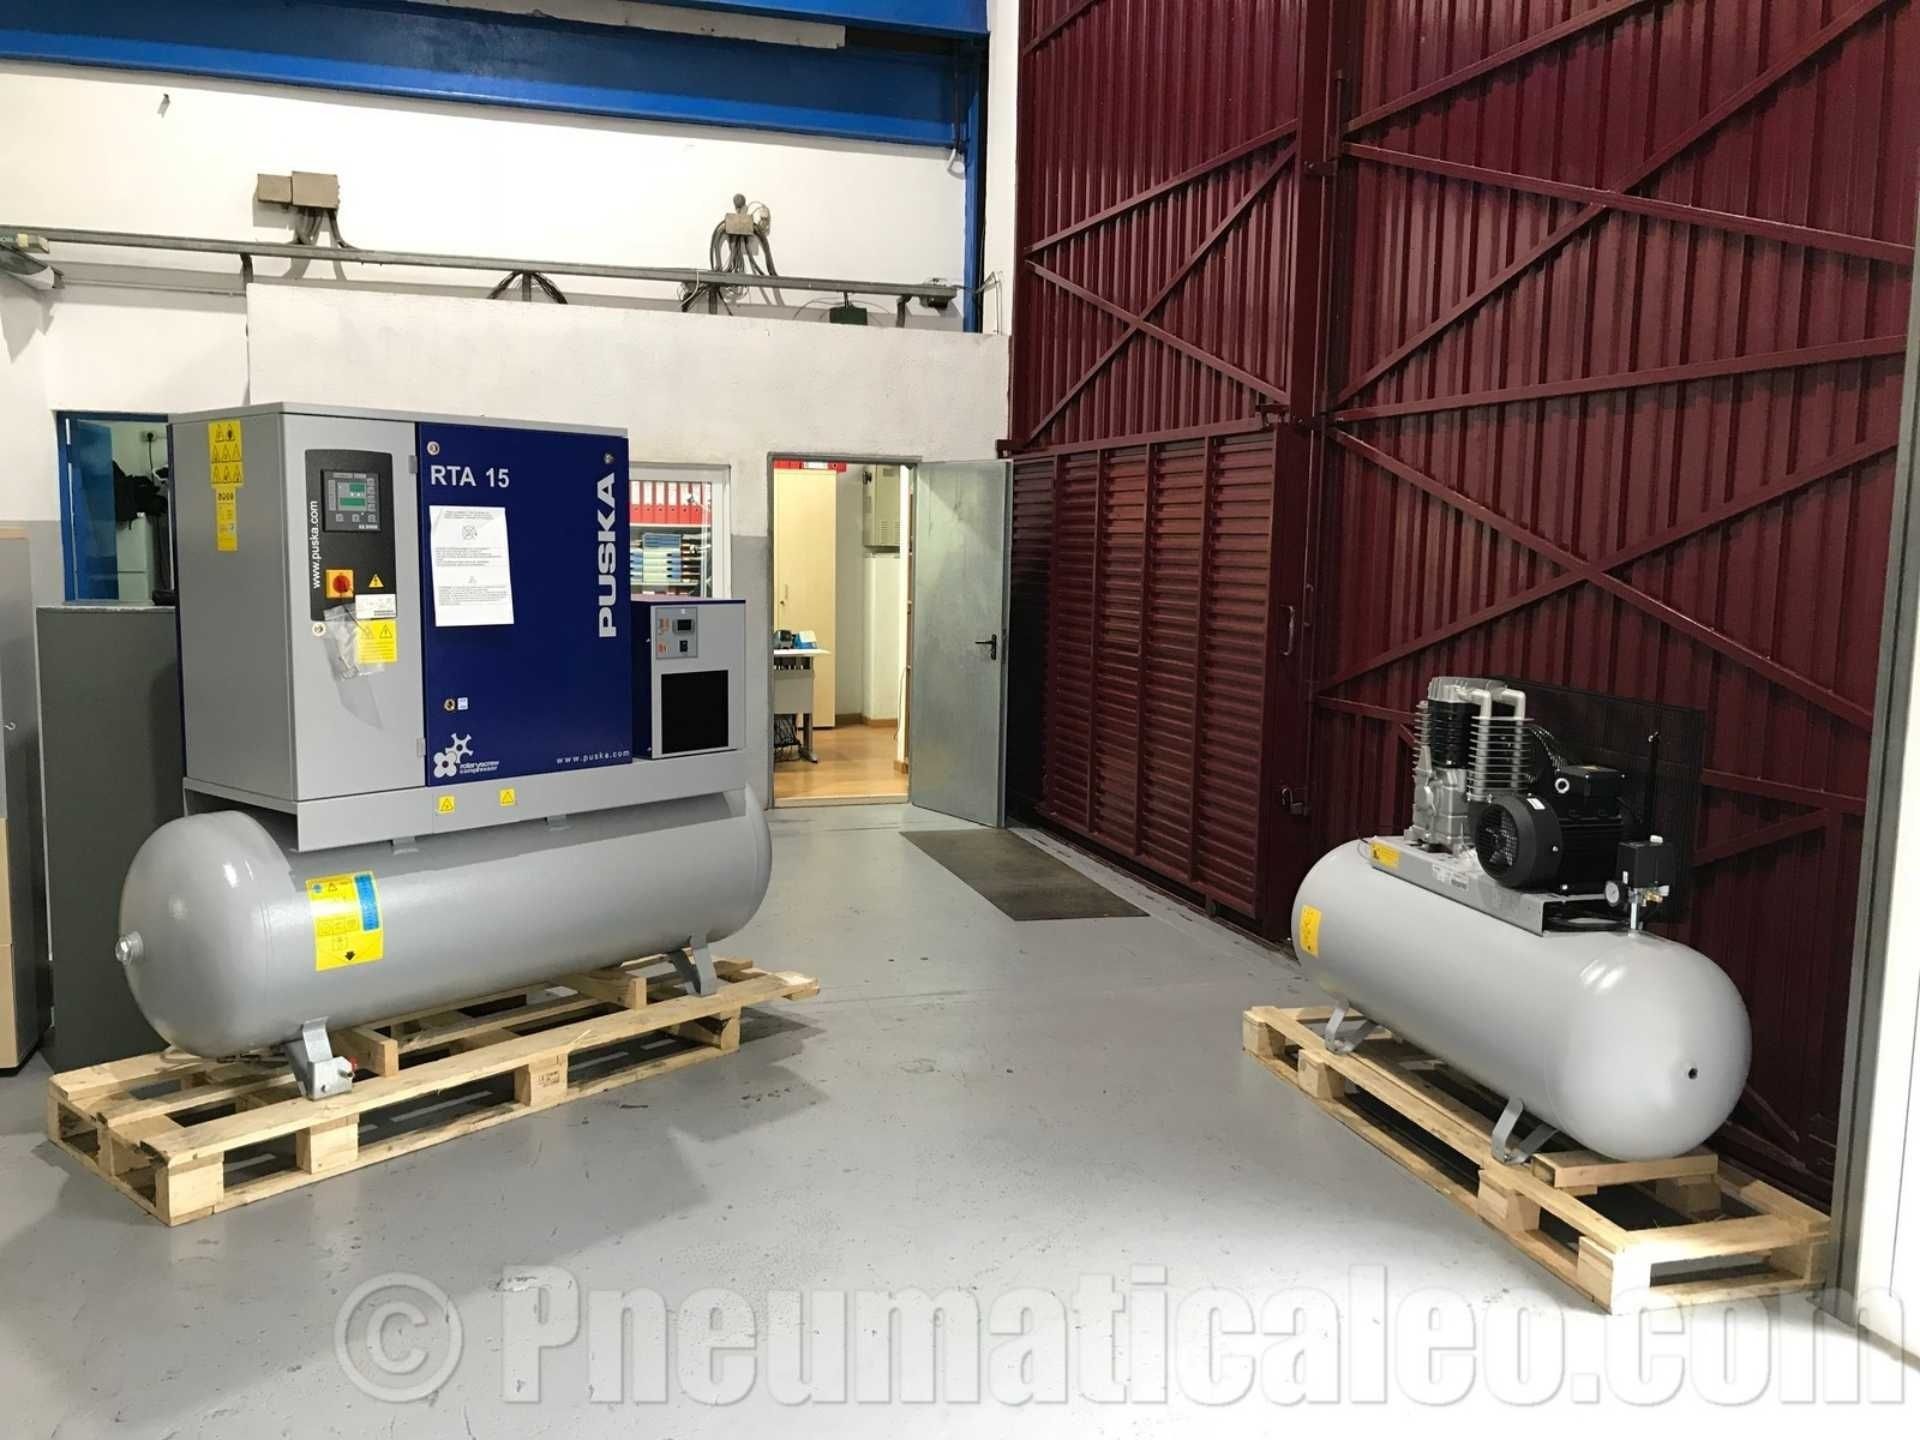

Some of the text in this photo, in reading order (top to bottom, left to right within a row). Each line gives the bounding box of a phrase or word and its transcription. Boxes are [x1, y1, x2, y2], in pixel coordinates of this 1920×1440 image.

[430, 464, 510, 488] RTA 15
[310, 500, 321, 589] www.puska.com
[598, 472, 617, 638] PUSKA
[556, 750, 630, 764] www.puska.com
